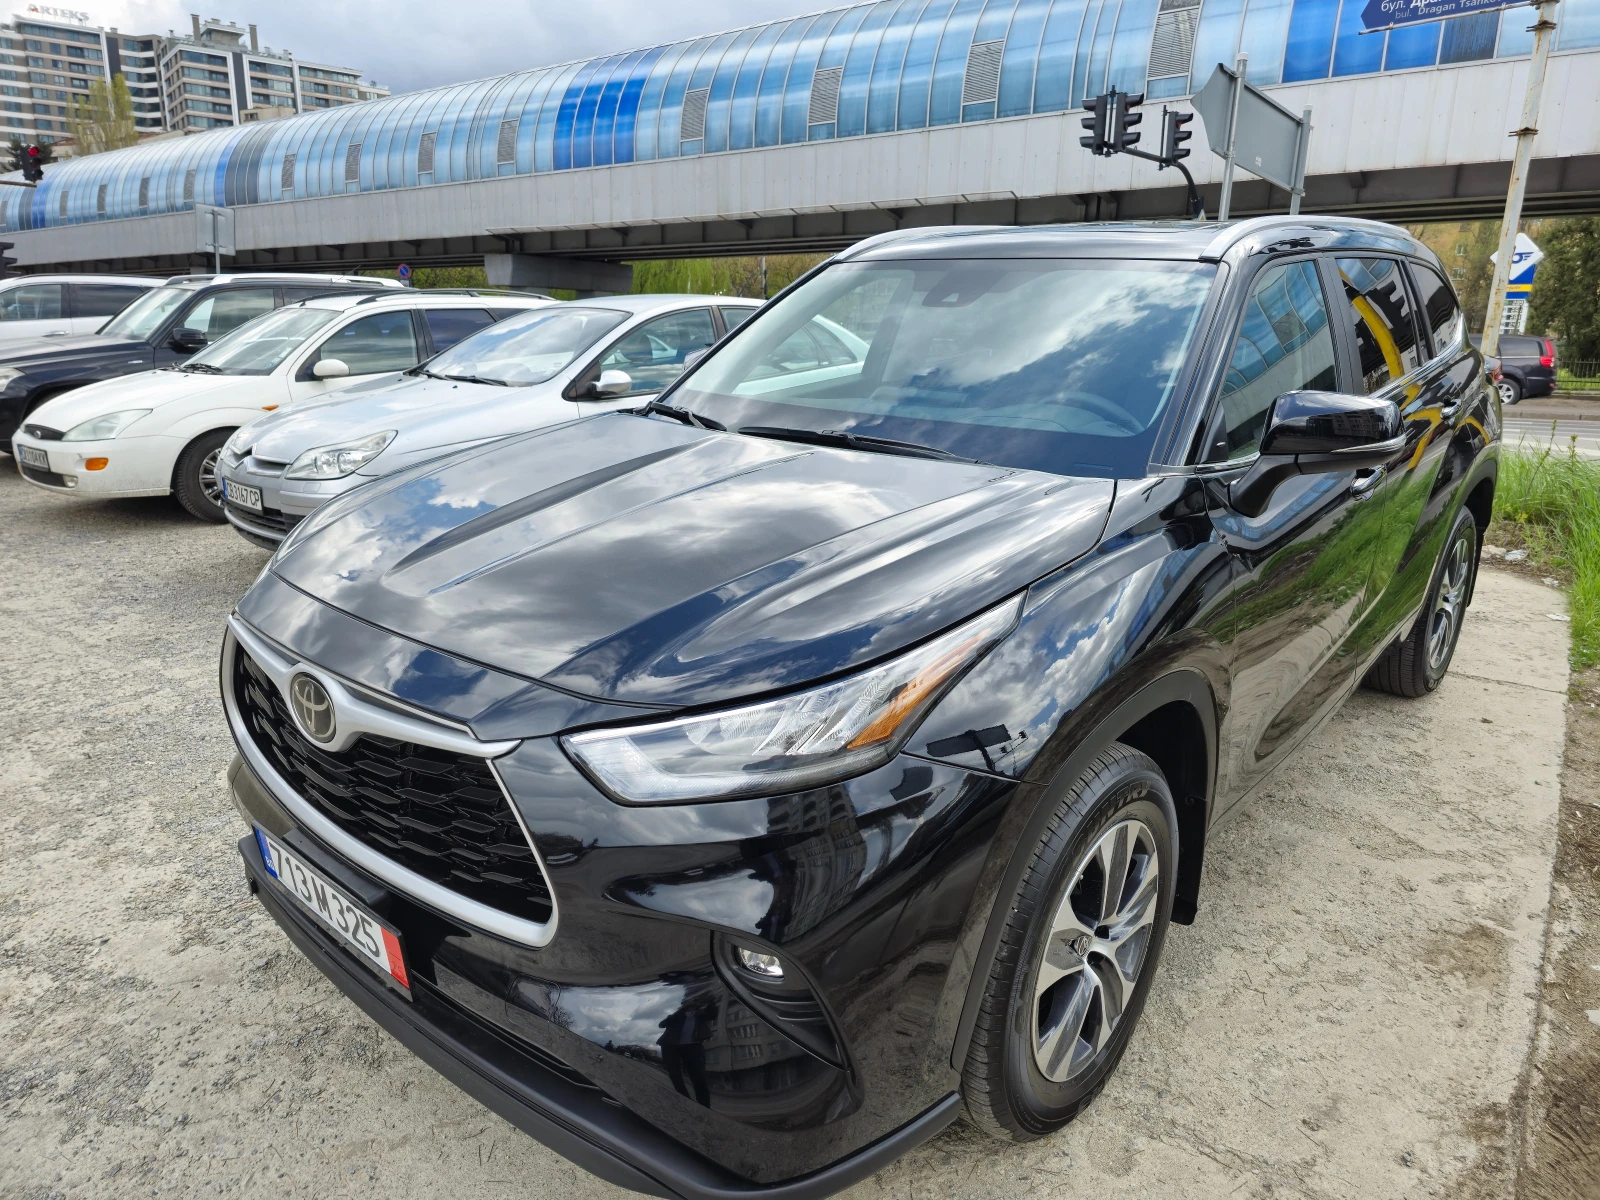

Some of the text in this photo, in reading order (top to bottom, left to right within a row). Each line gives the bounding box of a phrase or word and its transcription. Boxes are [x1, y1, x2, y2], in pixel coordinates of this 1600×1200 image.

[27, 3, 90, 21] ARTEKS
[1381, 0, 1406, 13] бул.
[1395, 9, 1412, 19] bul.
[1418, 3, 1456, 15] Dragan
